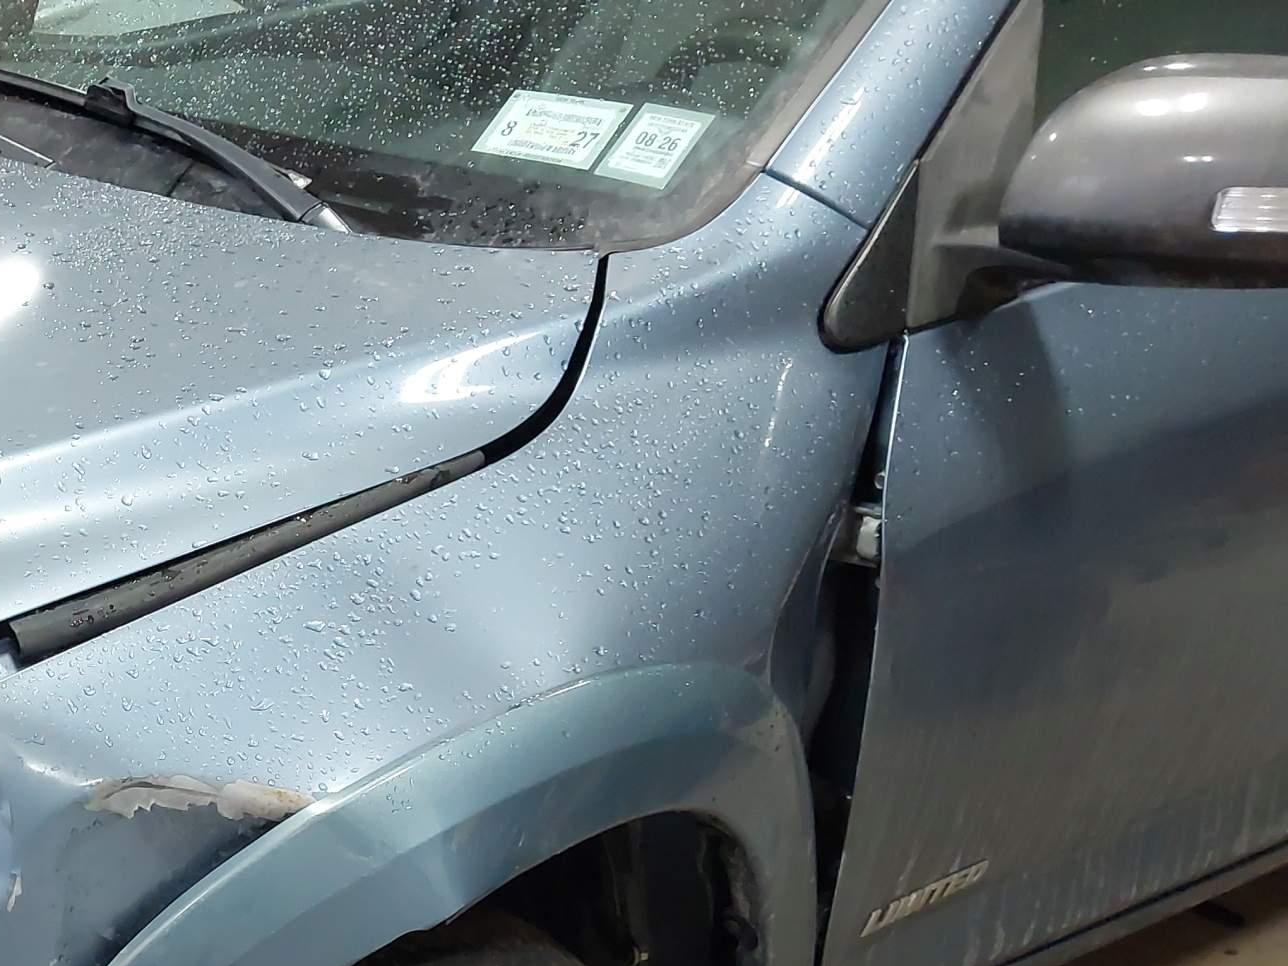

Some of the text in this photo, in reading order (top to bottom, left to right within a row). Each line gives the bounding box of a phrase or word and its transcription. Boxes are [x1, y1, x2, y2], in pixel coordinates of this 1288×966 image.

[501, 121, 518, 137] 8
[569, 131, 601, 150] 27
[635, 130, 658, 148] 08
[657, 136, 683, 152] 26
[860, 858, 990, 938] LIMITED
